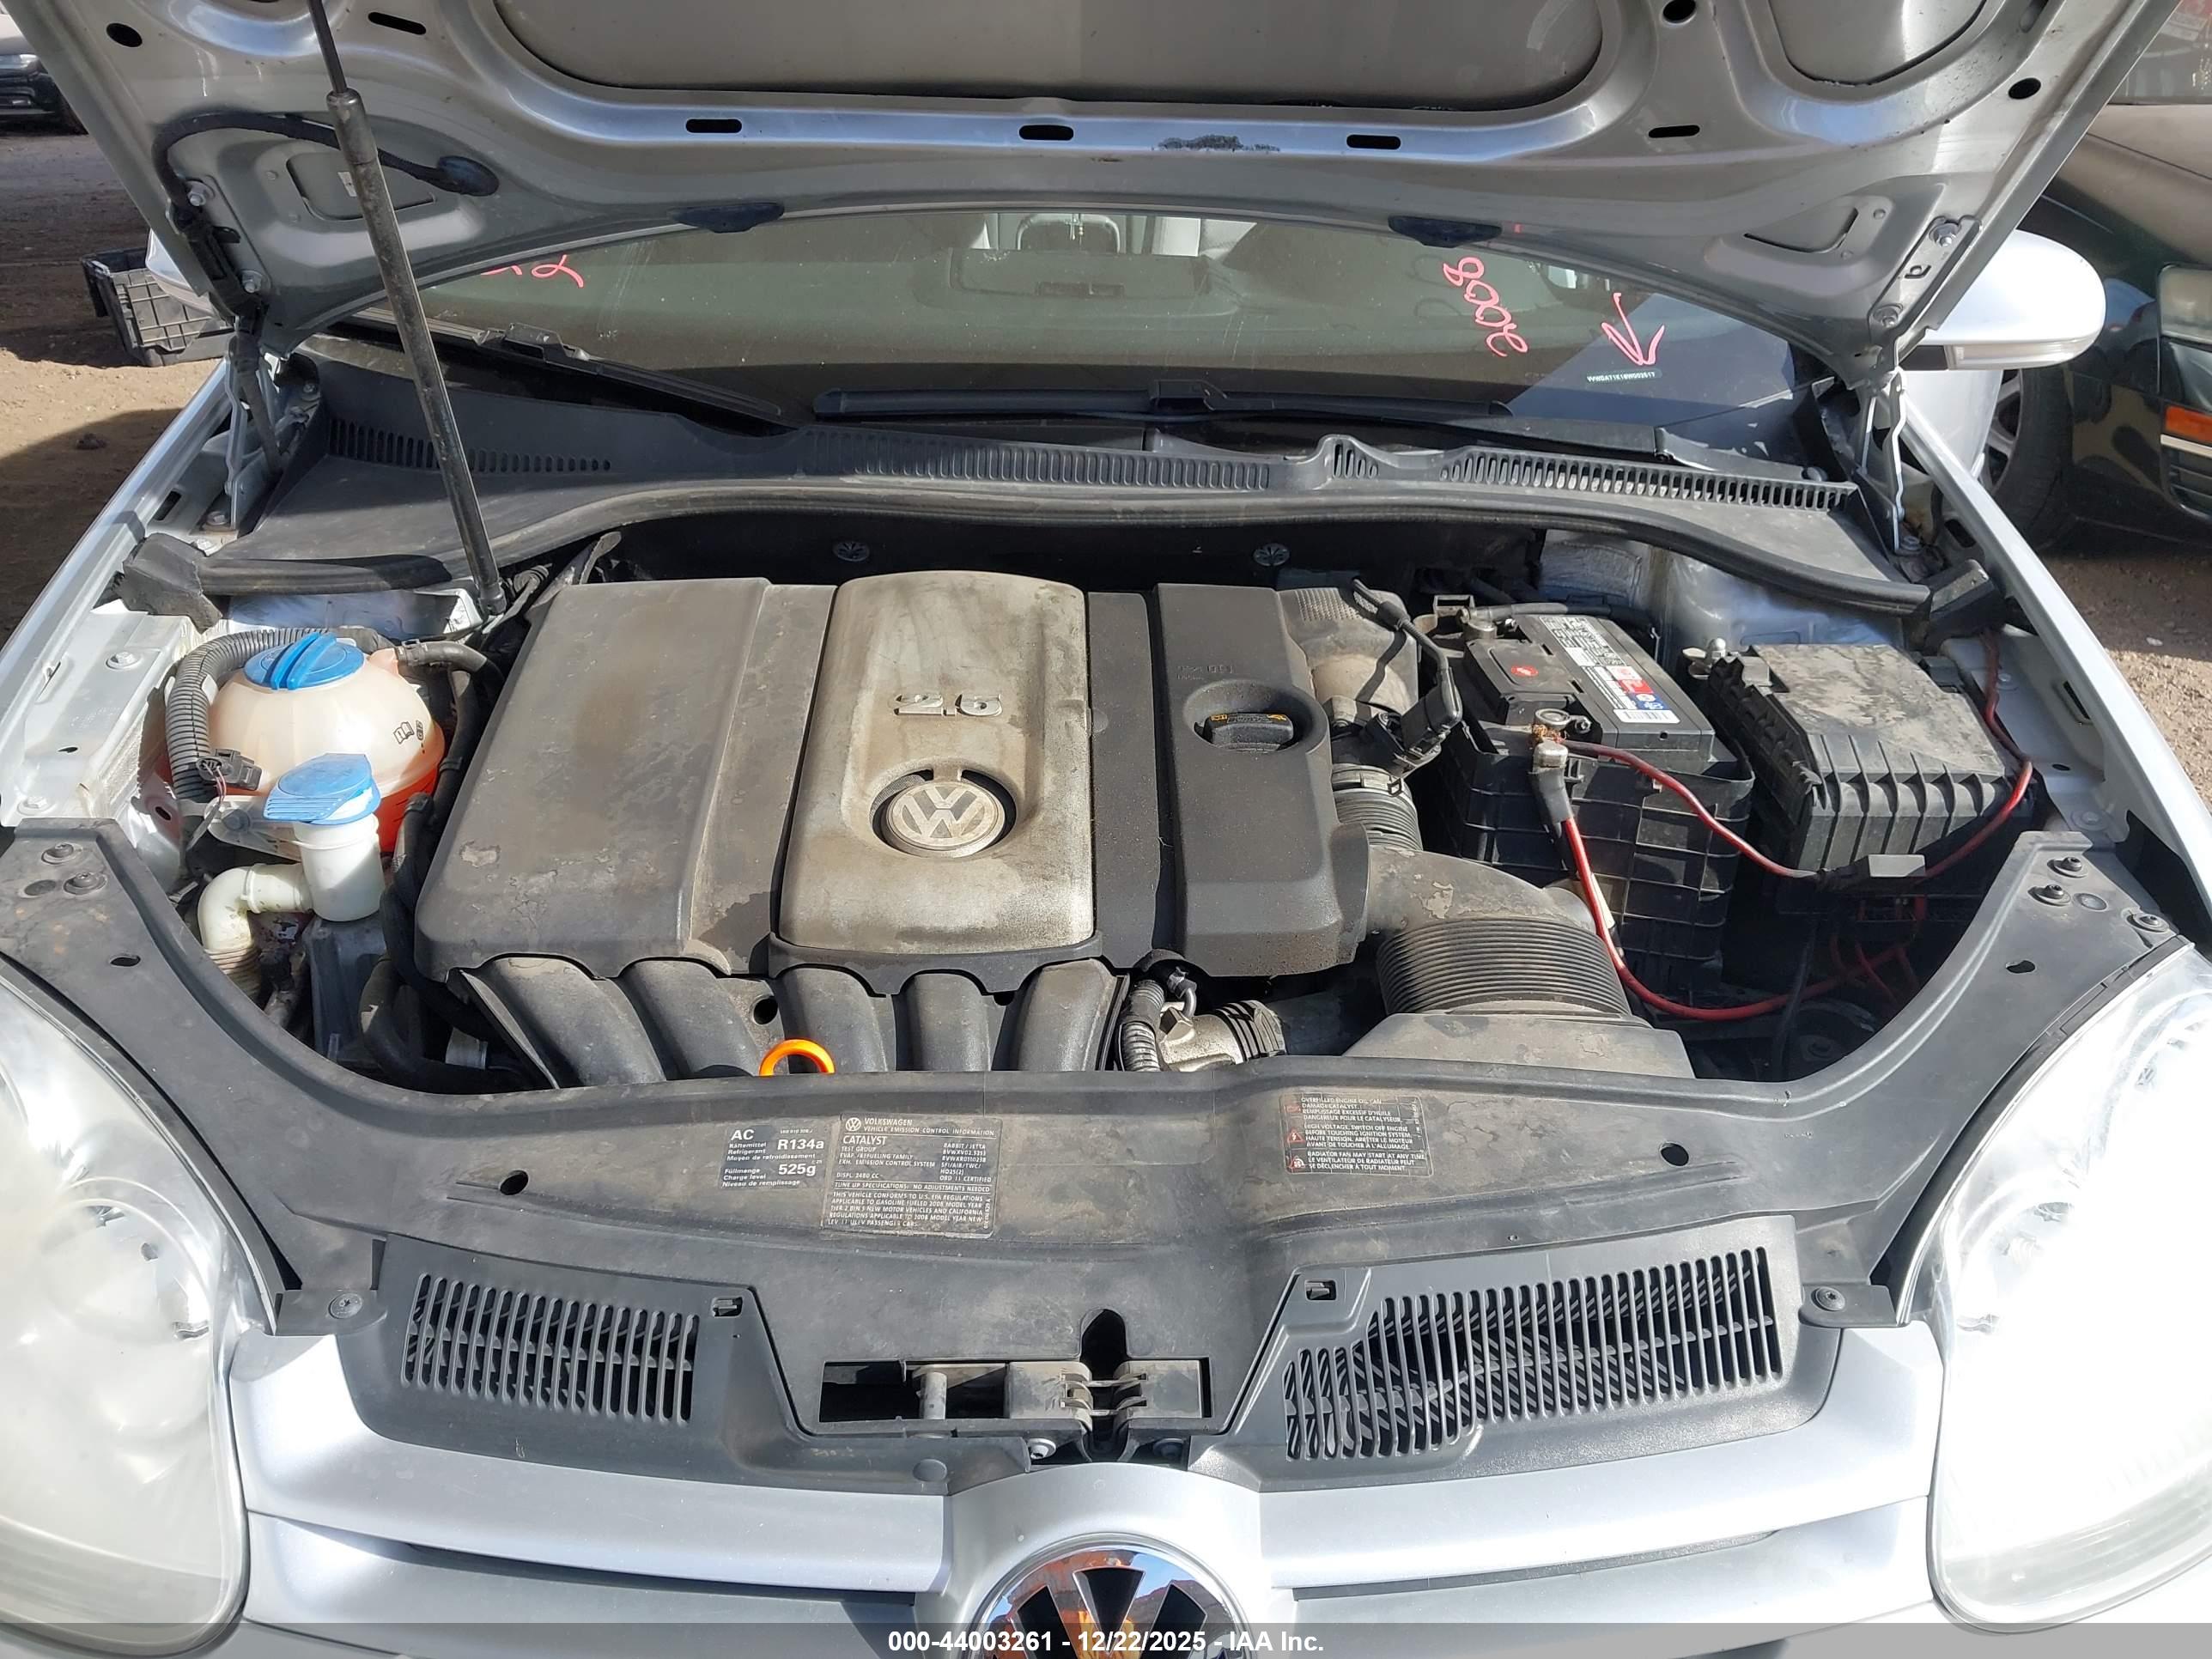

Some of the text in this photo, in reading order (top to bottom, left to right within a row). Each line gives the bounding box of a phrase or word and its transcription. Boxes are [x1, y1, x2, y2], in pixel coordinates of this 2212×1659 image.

[1443, 257, 1528, 357] 2008
[731, 1129, 754, 1140] AC
[843, 1135, 888, 1146] CATALYST
[777, 1139, 824, 1151] R134a
[778, 1163, 816, 1176] 525g
